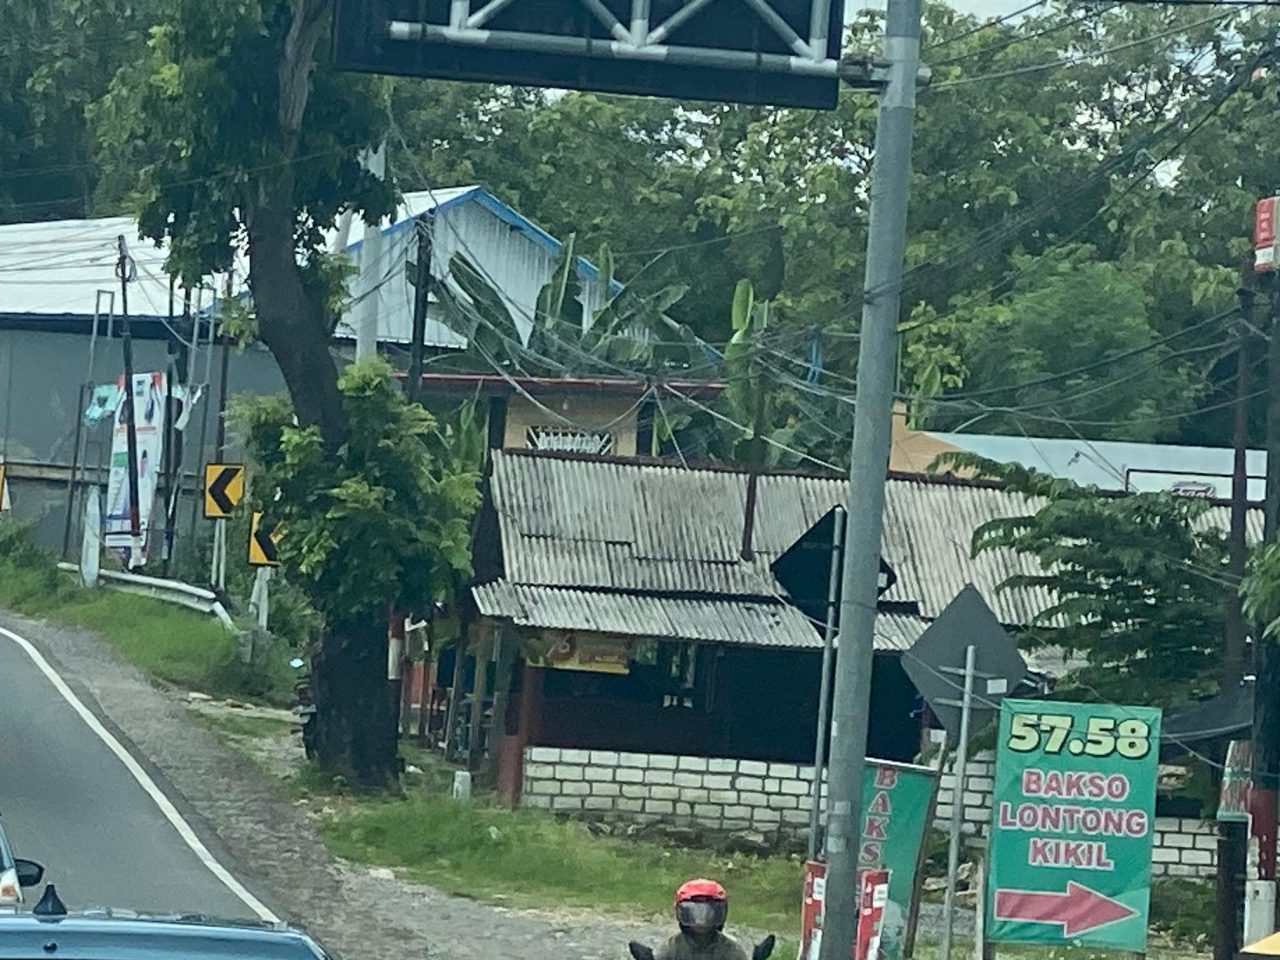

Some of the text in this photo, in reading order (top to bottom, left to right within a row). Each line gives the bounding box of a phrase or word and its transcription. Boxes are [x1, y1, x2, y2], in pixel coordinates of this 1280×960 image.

[1007, 712, 1151, 759] 57.58
[1023, 769, 1129, 801] BAKSO
[857, 766, 899, 868] BAKS
[999, 801, 1149, 837] LONTONG
[1028, 837, 1115, 871] KIKIL
